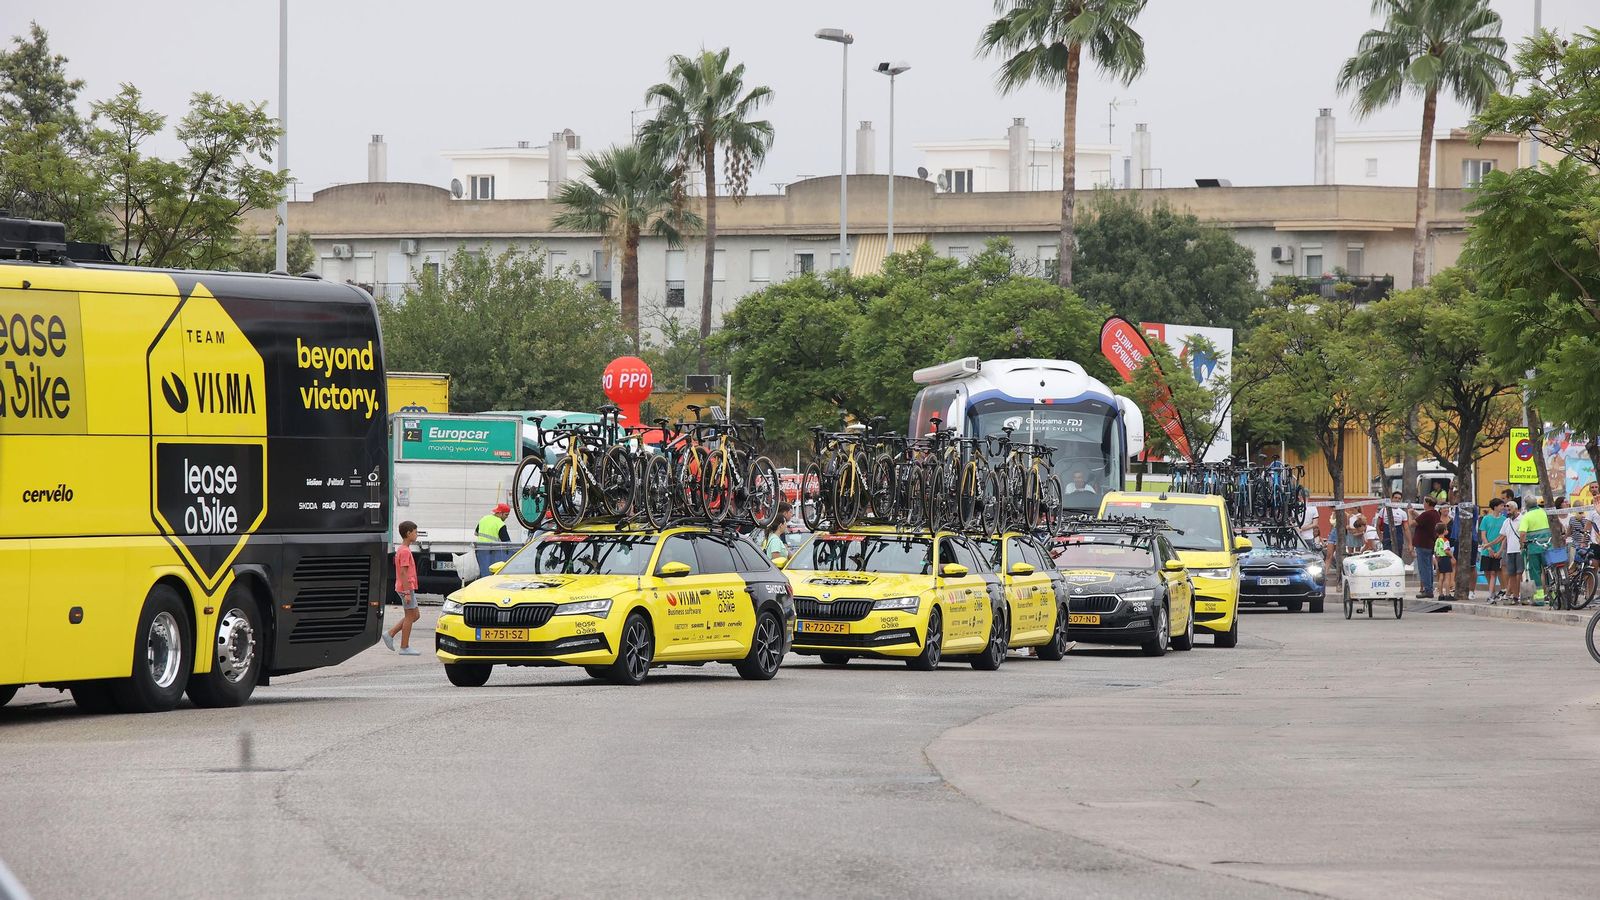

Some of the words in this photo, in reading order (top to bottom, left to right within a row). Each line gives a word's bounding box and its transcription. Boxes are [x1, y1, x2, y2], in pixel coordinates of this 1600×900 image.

[186, 330, 225, 344] TEAM
[296, 338, 374, 378] beyond
[619, 373, 648, 388] PPO
[194, 372, 256, 414] VISMA
[300, 380, 379, 419] victory.
[428, 427, 490, 441] Europcar
[184, 458, 237, 495] lease
[23, 484, 73, 503] cervélo
[678, 591, 701, 606] VISMA
[716, 589, 734, 599] lease
[485, 630, 523, 638] R-751-SZ
[805, 624, 844, 632] R-720-ZF
